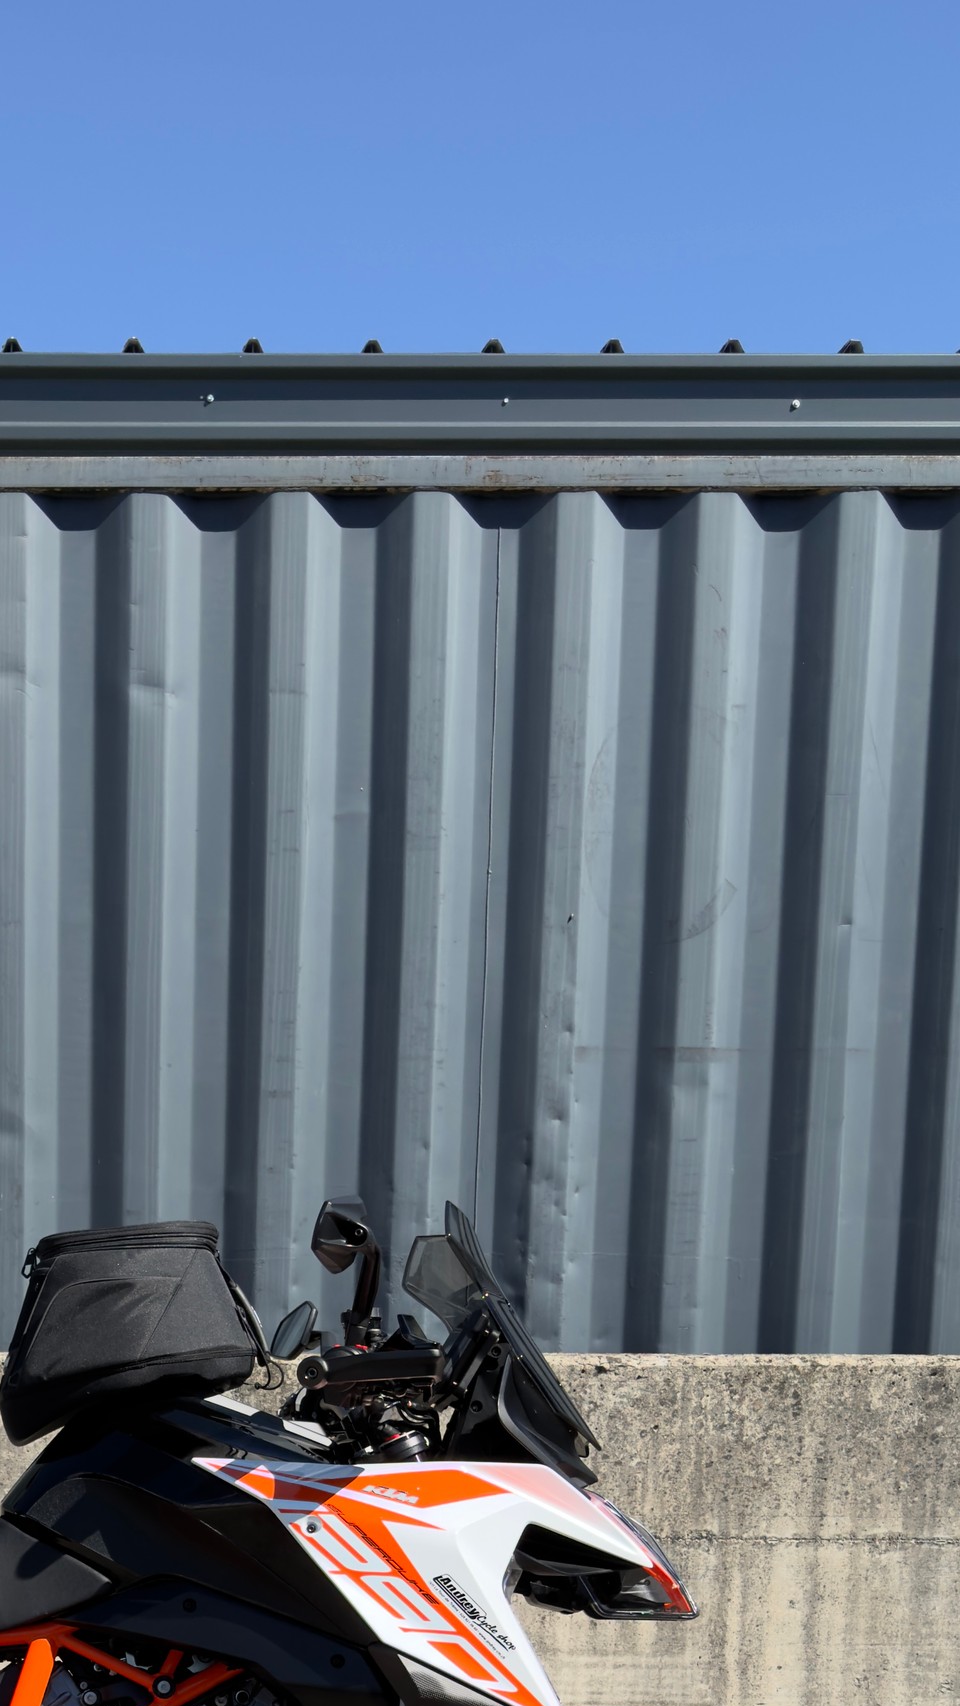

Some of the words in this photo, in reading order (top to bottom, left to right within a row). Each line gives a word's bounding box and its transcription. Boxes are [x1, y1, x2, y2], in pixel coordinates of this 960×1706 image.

[440, 1576, 480, 1617] Andrey
[477, 1615, 498, 1634] Cycle
[497, 1634, 516, 1651] shop
